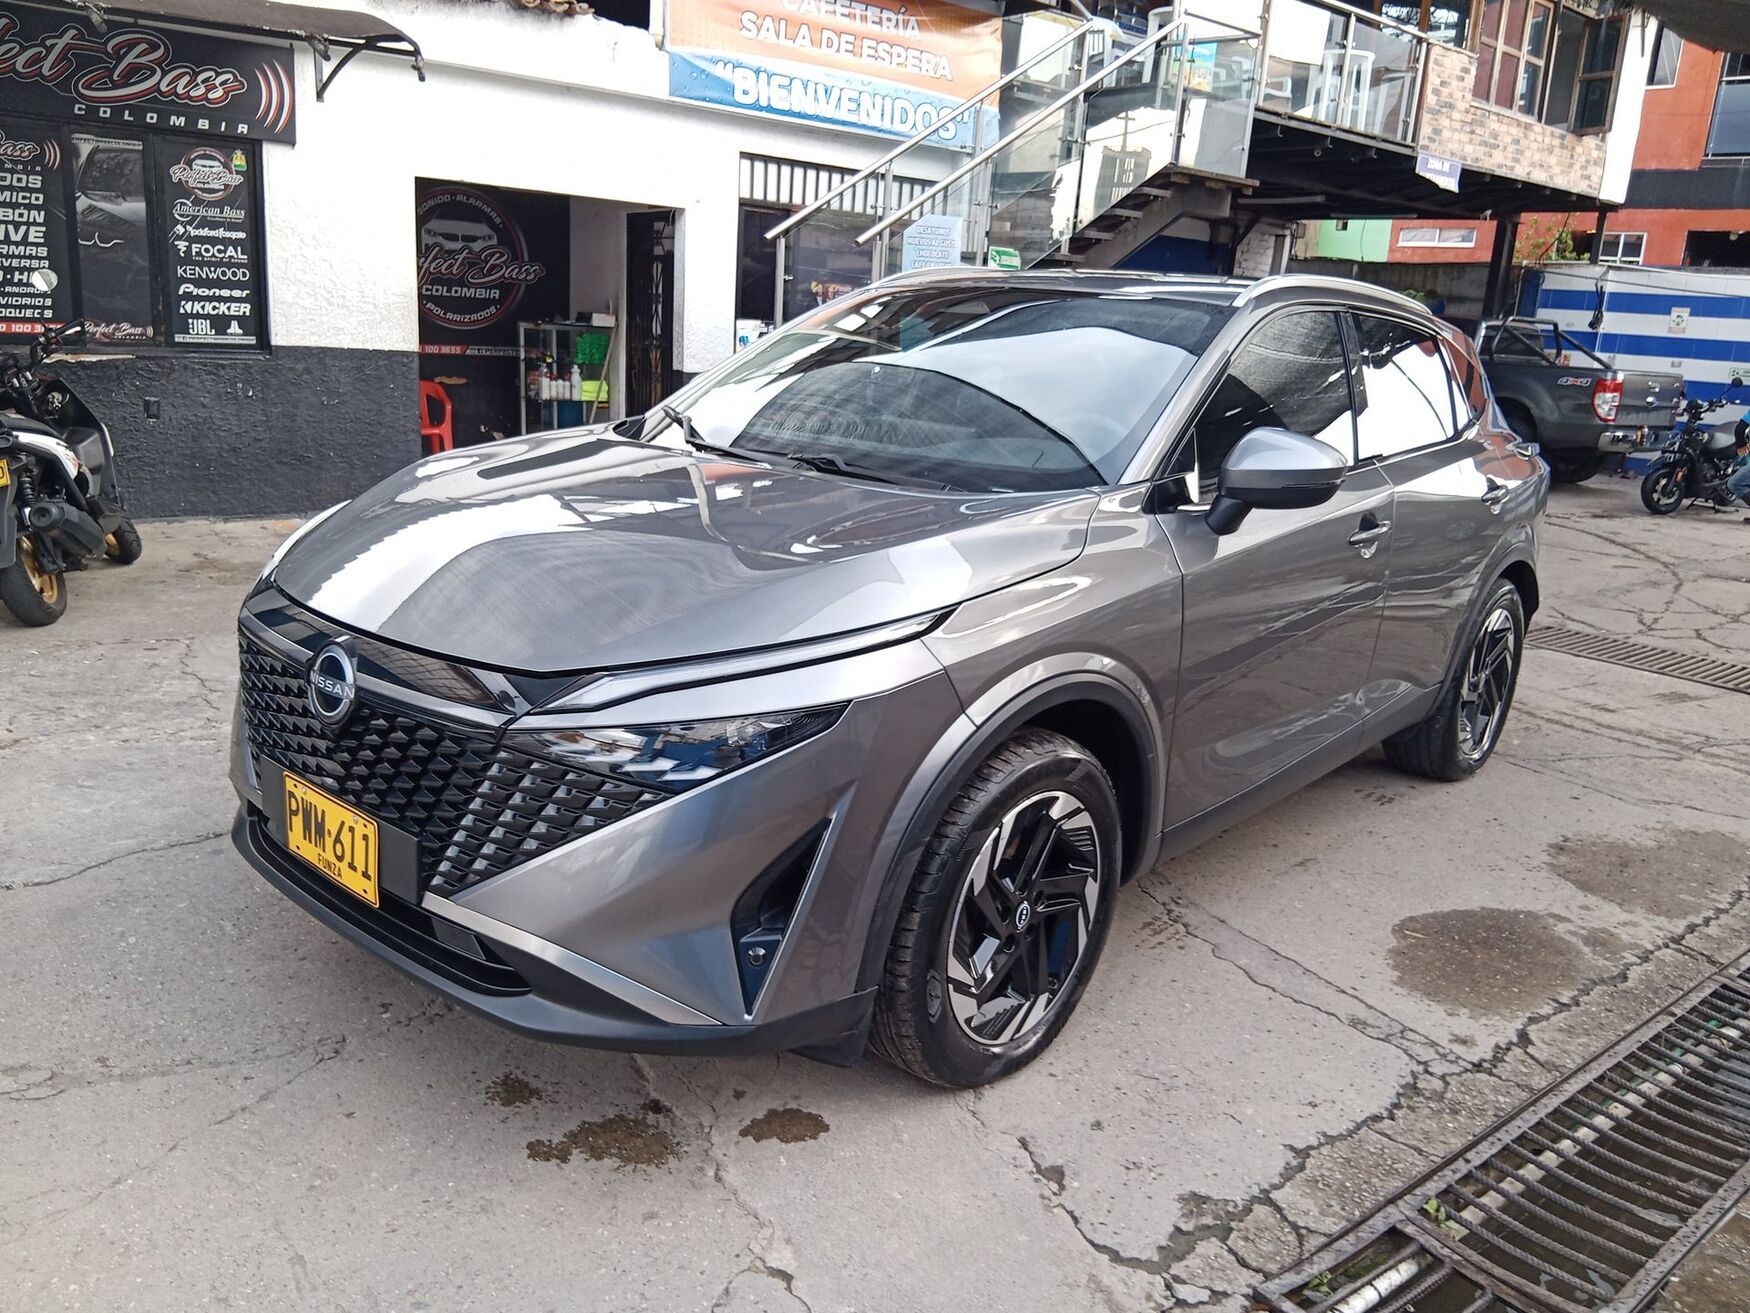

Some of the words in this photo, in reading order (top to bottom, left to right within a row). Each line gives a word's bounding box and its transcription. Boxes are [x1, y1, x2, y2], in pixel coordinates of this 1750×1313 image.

[783, 0, 921, 38] CAFETERÍA
[739, 10, 813, 50] SALA
[820, 29, 856, 57] DE
[861, 37, 953, 81] ESPERA
[0, 16, 88, 81] ect
[77, 30, 247, 105] Bass
[74, 103, 249, 135] COLOMBIA
[0, 172, 43, 189] DOS
[0, 206, 45, 223] BÓN
[173, 203, 220, 216] American
[223, 206, 246, 218] Bass
[191, 243, 248, 259] FOCAL
[177, 265, 250, 281] KENWOOD
[467, 247, 543, 285] Bass
[178, 283, 251, 298] Pioneer
[422, 284, 500, 300] COLOMBIA
[192, 300, 252, 316] KICKER
[425, 301, 497, 322] POLARIZADOS
[188, 318, 216, 335] JBL
[310, 670, 355, 698] NISSAN
[317, 853, 343, 880] FUNZA
